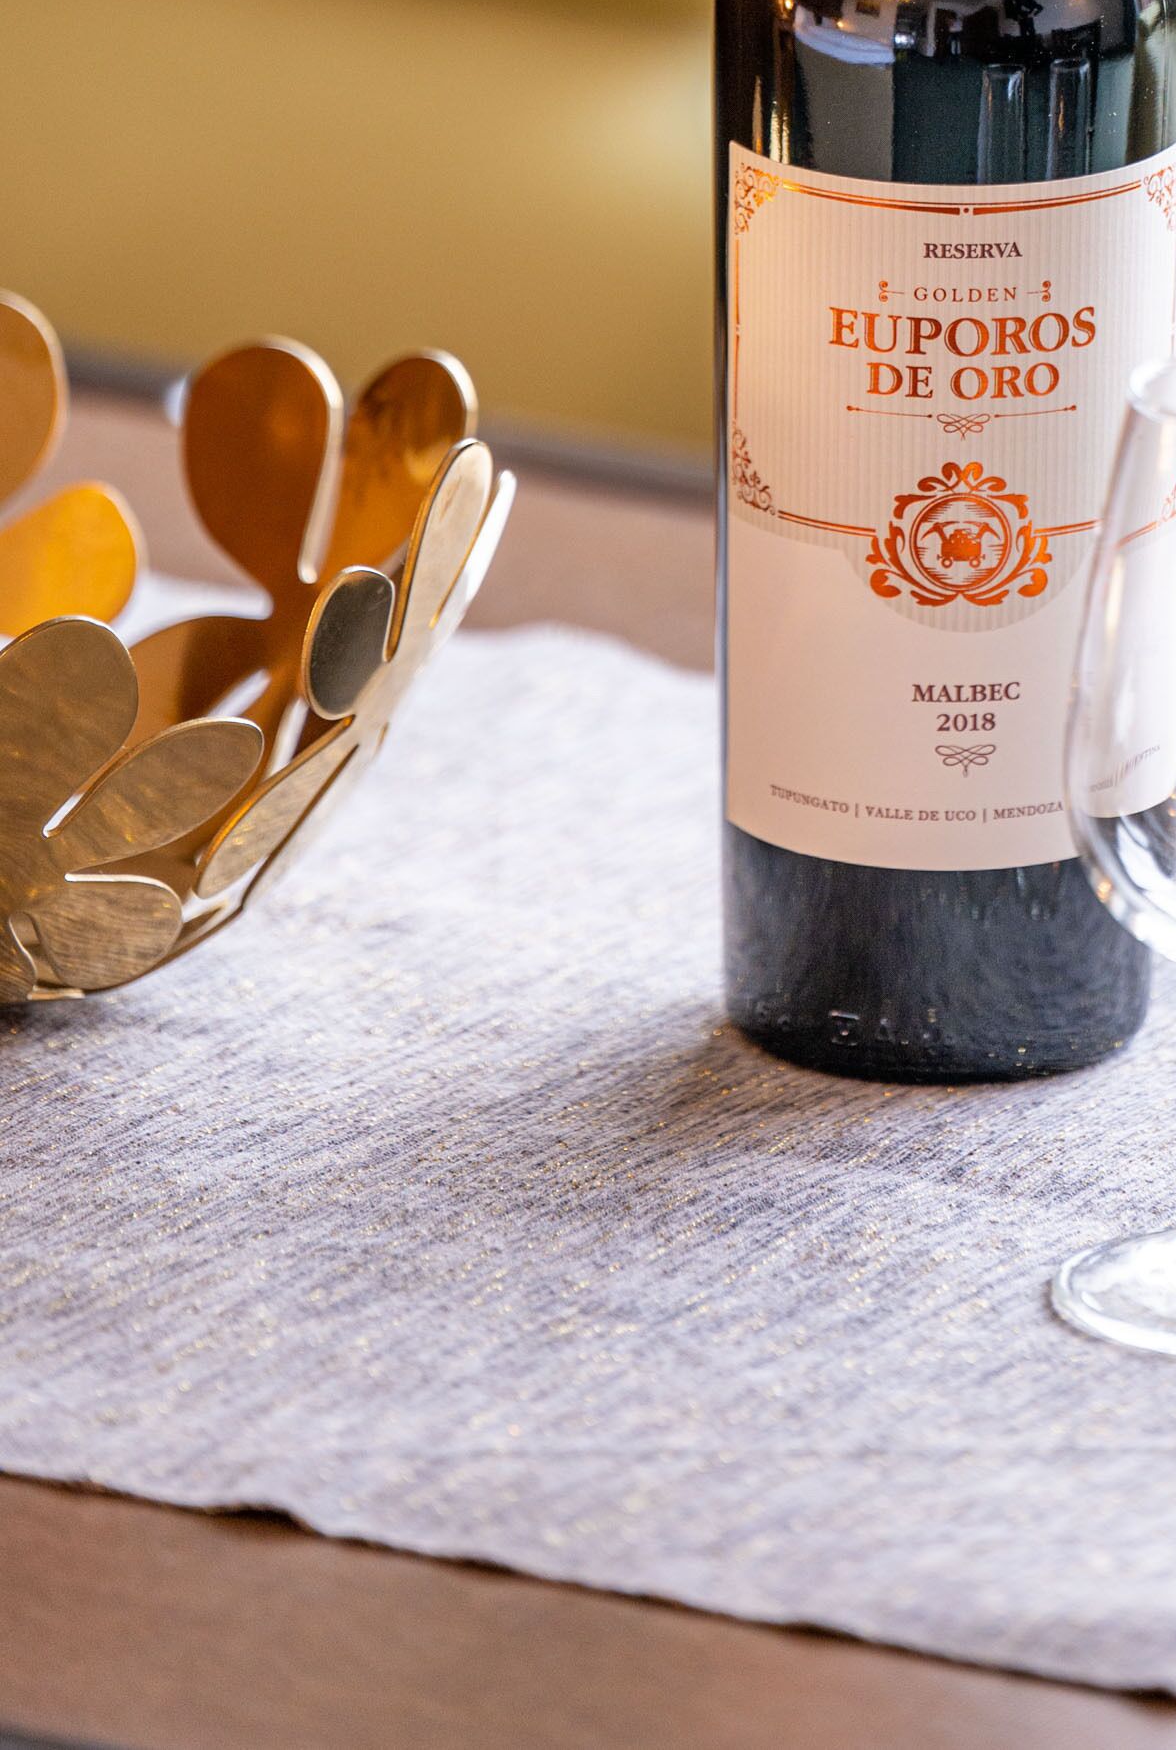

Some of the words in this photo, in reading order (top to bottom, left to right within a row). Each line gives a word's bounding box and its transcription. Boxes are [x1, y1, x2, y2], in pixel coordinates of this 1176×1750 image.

[923, 242, 1023, 260] RESERVA
[914, 287, 1018, 302] GOLDEN
[828, 306, 1096, 357] EUPOROS
[866, 362, 933, 399] DE
[950, 362, 1060, 400] ORO
[912, 682, 1021, 703] MALBEC
[936, 712, 996, 732] 2018
[770, 784, 849, 813] TUPUNGATO
[865, 806, 913, 820] VALLE
[918, 809, 939, 822] DE
[944, 809, 976, 822] UCO
[993, 801, 1063, 820] MENDOZA
